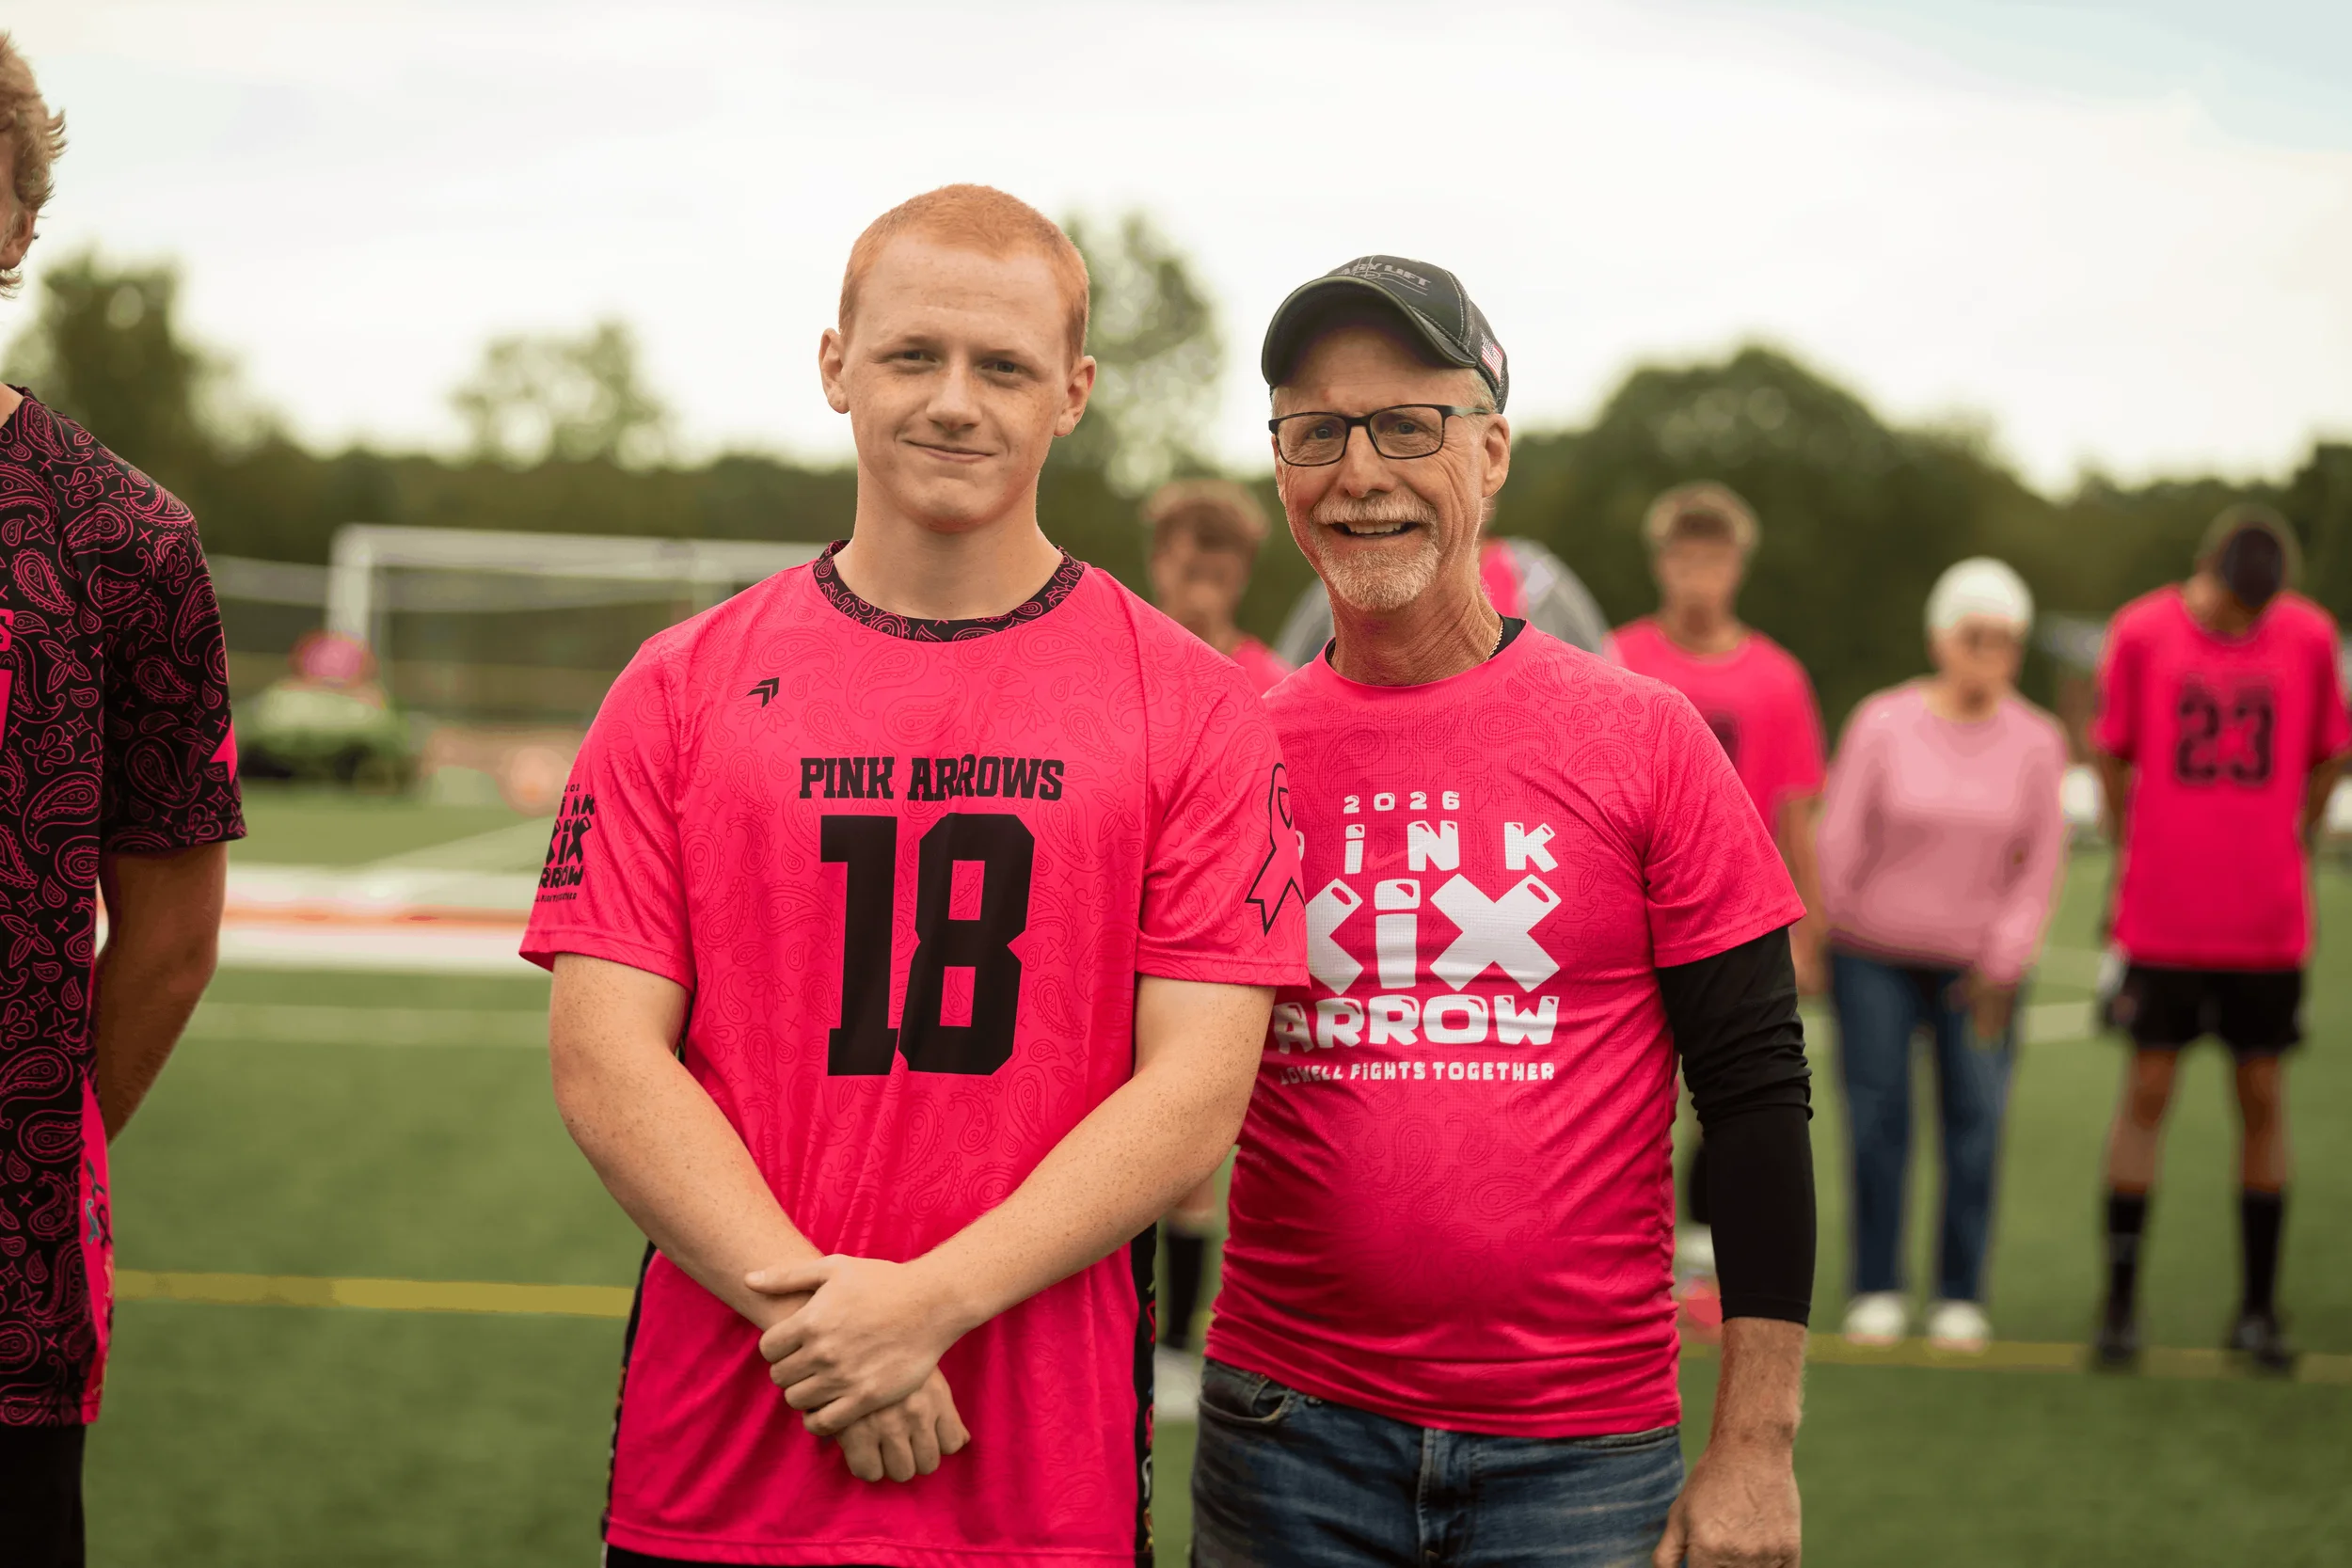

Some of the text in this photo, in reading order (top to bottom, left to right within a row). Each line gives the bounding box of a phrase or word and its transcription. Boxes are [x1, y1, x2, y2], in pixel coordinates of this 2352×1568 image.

[1384, 264, 1432, 287] LIFT
[2174, 679, 2273, 784] 23
[799, 753, 1065, 801] PINK ARROWS
[1343, 790, 1460, 814] 2026
[1295, 819, 1559, 875] iNK
[538, 864, 584, 889] RROW
[819, 812, 1035, 1077] 18
[1273, 994, 1560, 1054] ARROW
[1279, 1065, 1343, 1085] LOWELL
[1433, 1061, 1555, 1082] TOGETHER
